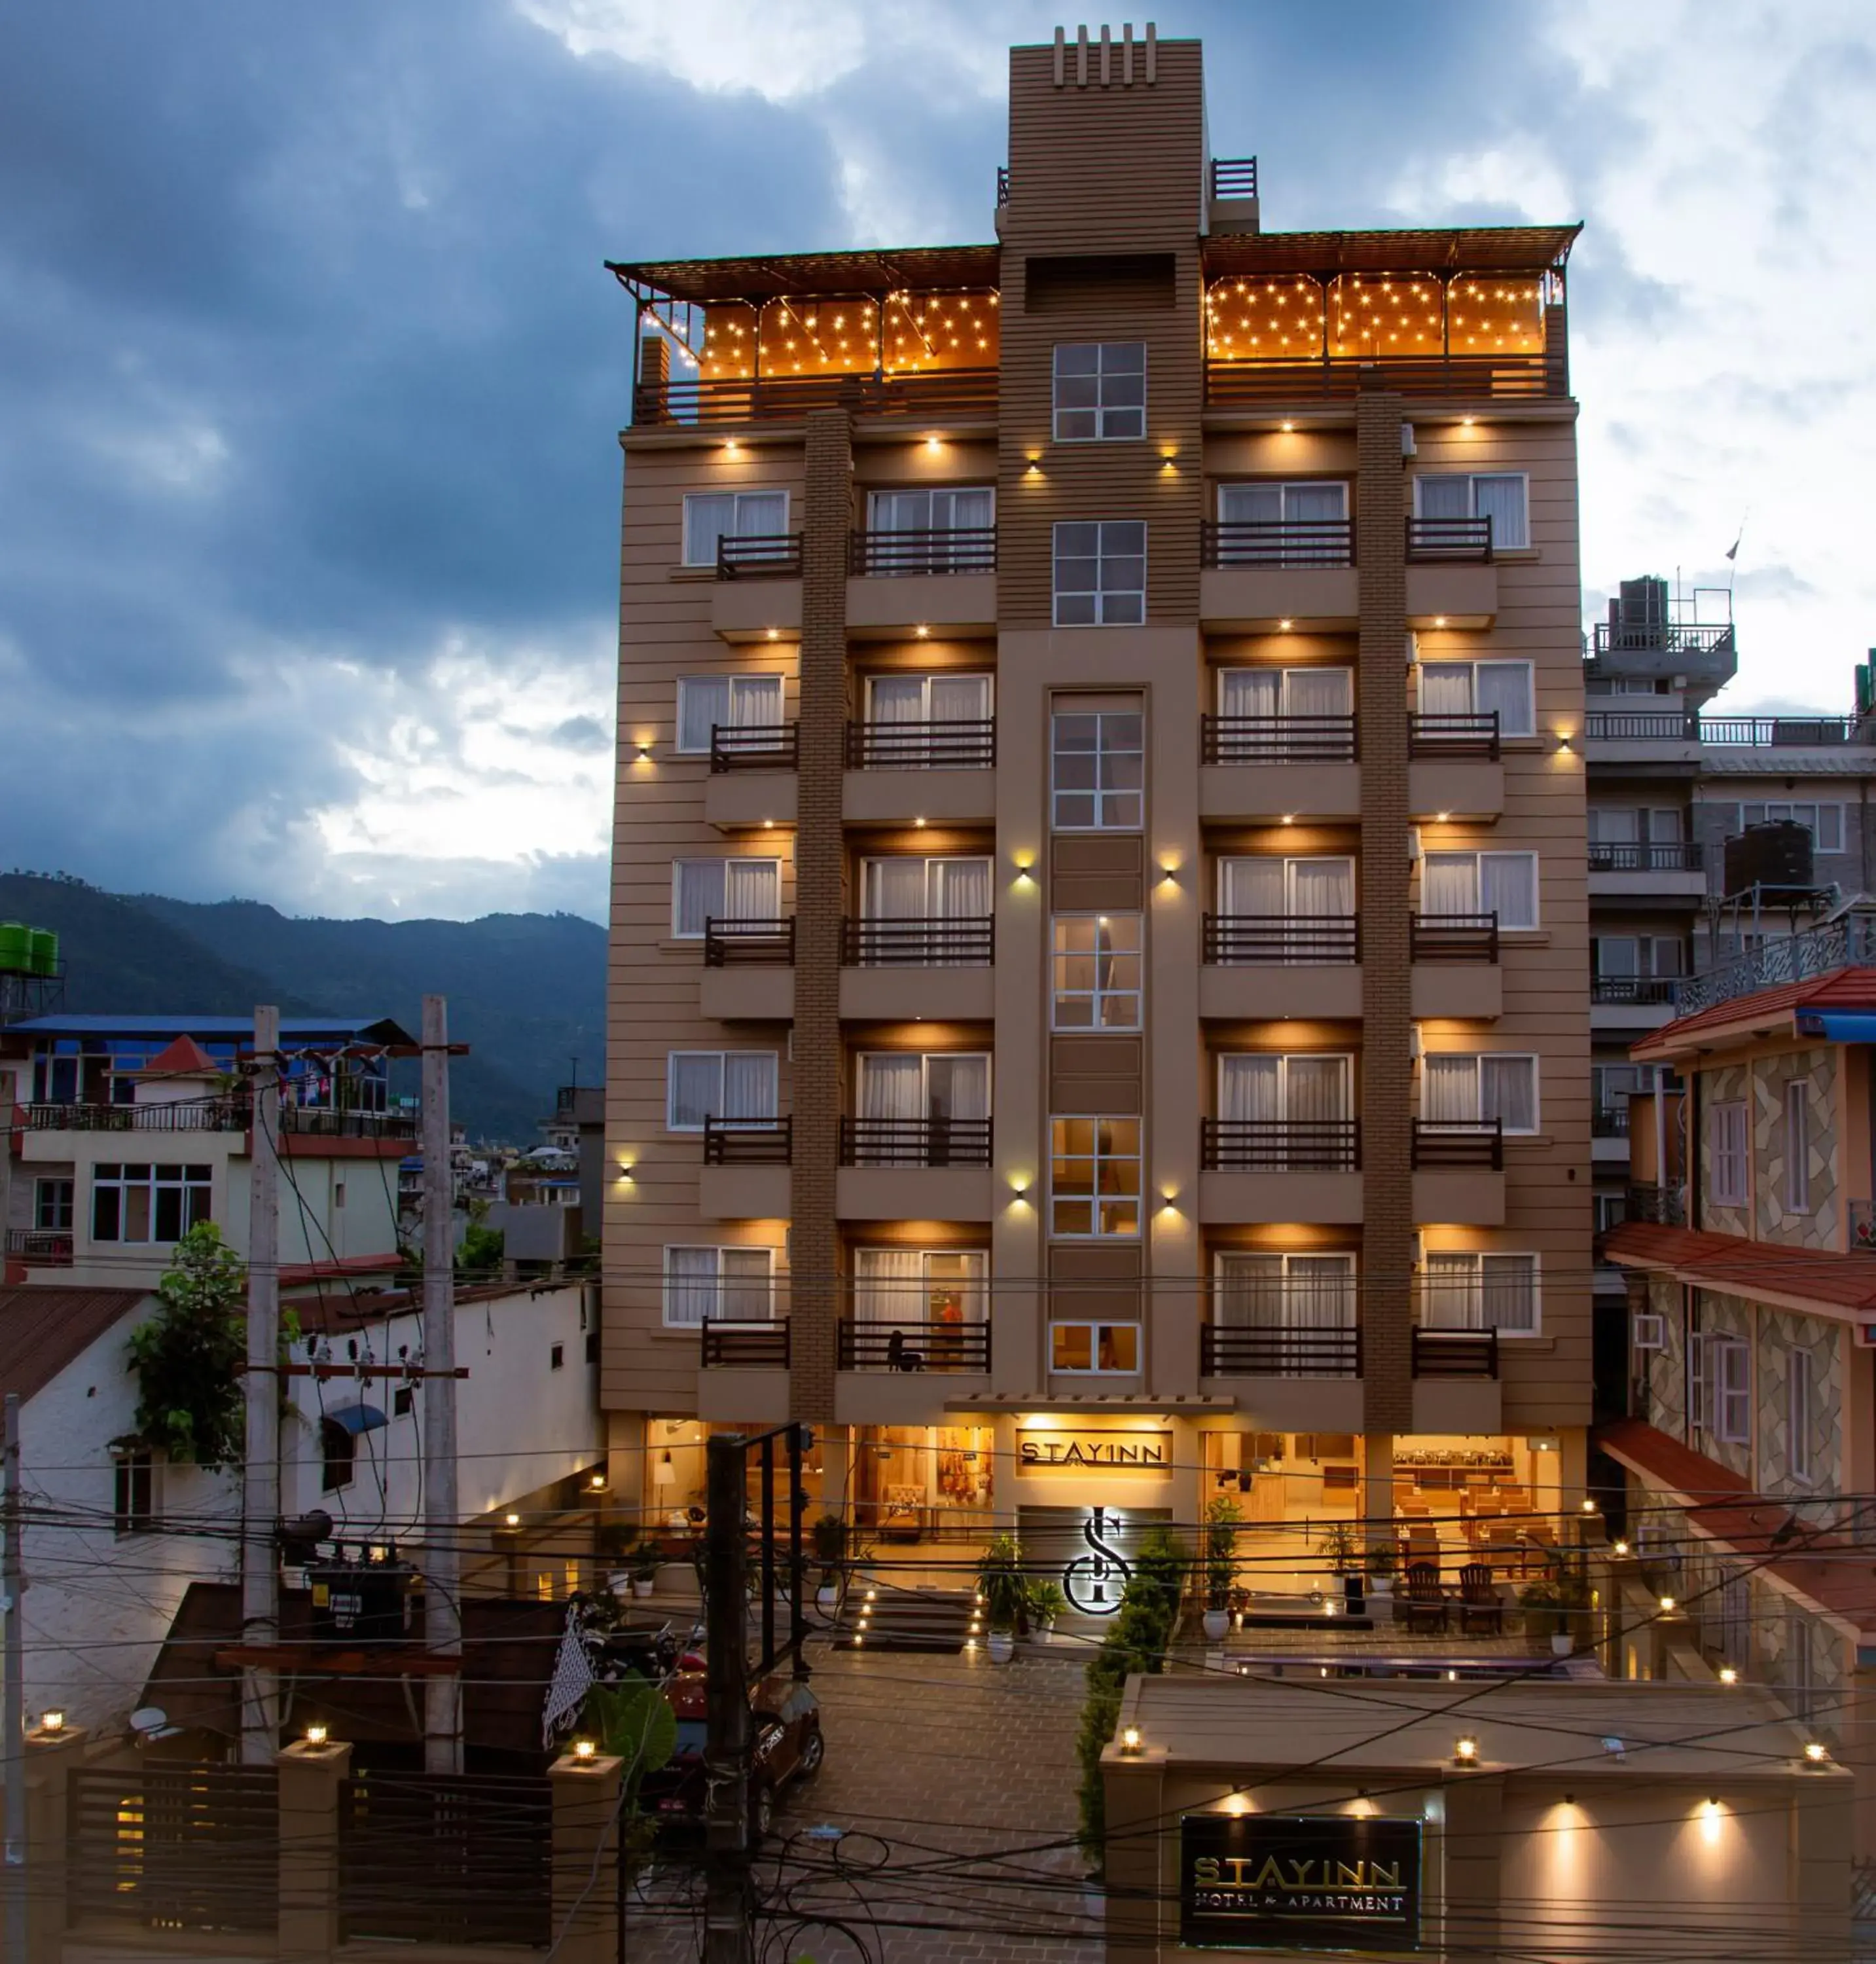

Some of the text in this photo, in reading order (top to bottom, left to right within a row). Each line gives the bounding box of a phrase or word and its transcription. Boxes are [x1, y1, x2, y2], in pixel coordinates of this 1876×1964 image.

[1021, 1440, 1163, 1464] STAYINN
[1194, 1854, 1399, 1889] STAYINN
[1195, 1892, 1259, 1908] HOTEL
[1288, 1895, 1403, 1911] APARTMENT
